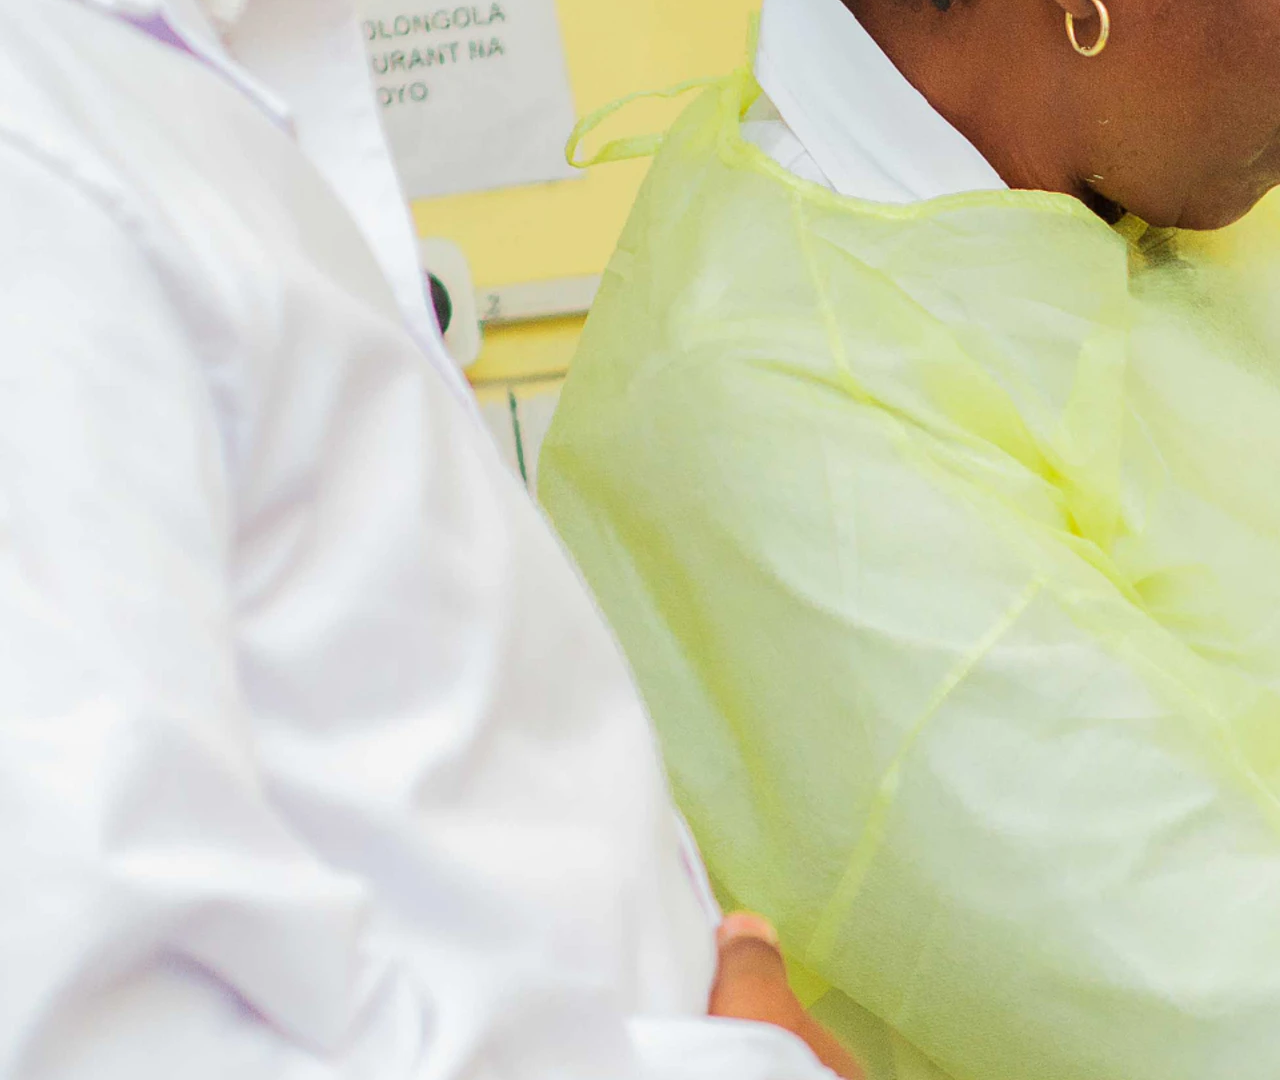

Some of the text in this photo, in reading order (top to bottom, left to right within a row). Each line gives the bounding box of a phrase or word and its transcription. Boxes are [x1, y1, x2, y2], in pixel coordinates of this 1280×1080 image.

[364, 1, 505, 41] OLONGOLA
[373, 36, 505, 74] URANT NA
